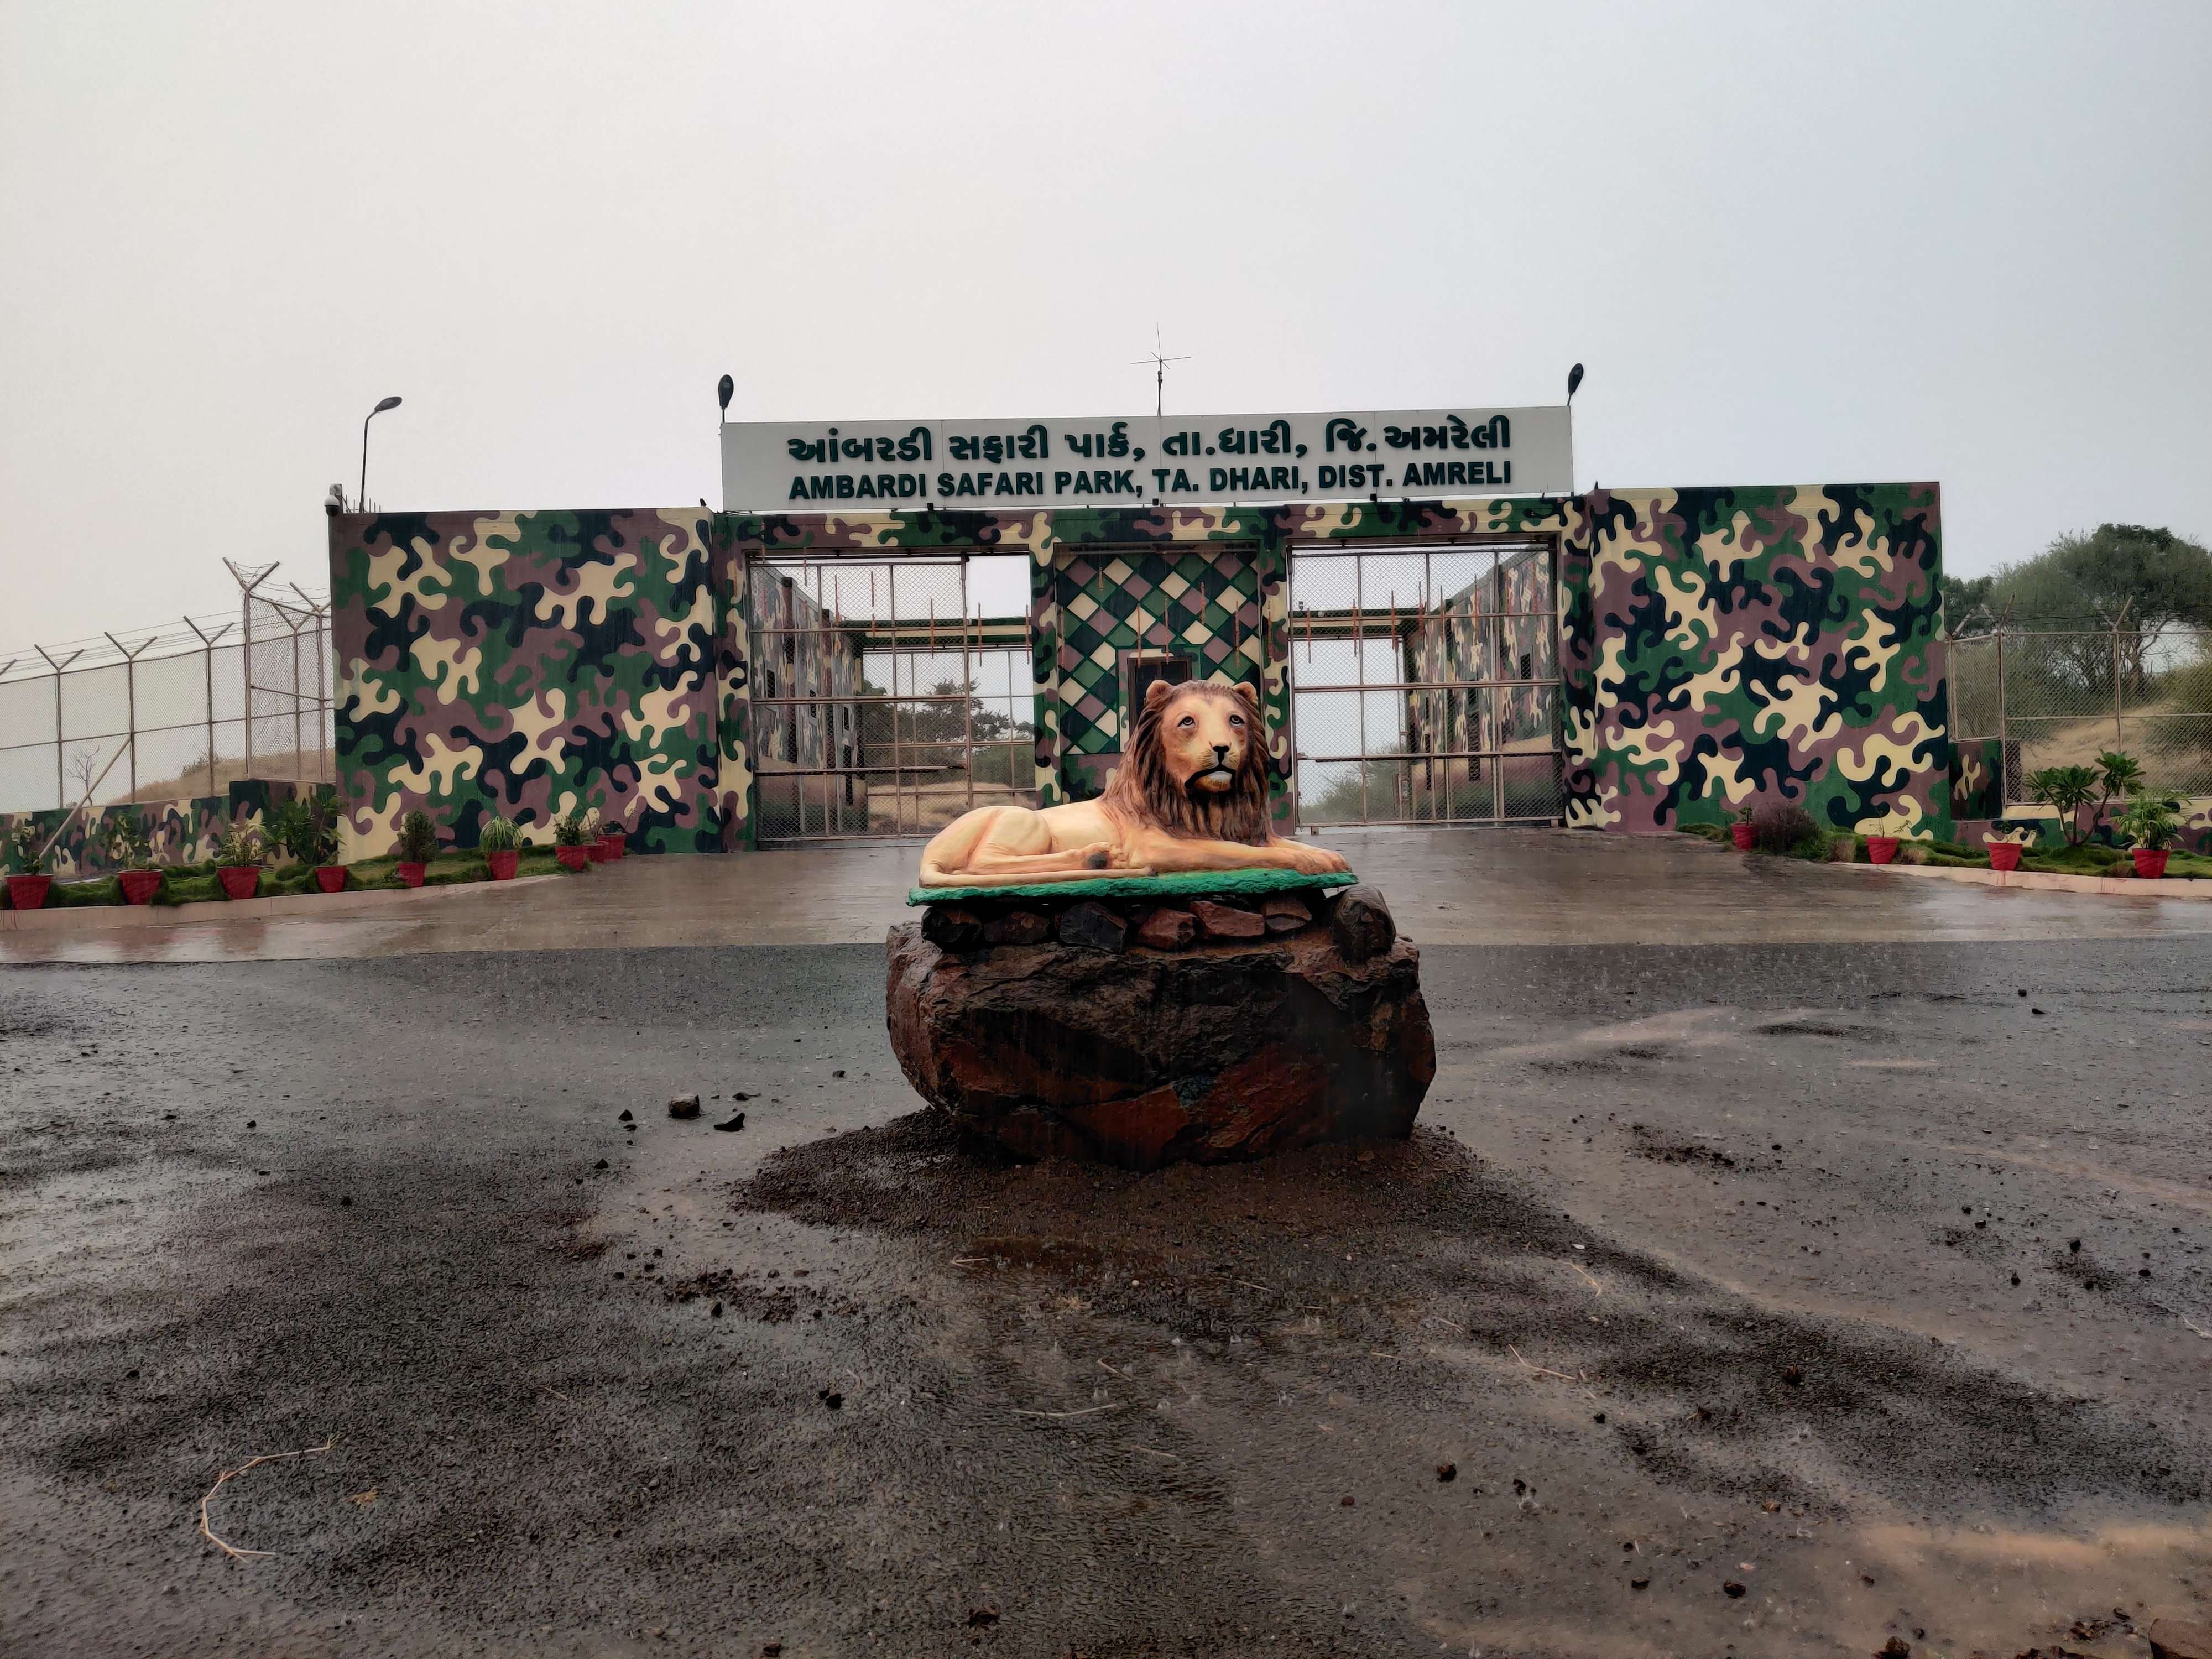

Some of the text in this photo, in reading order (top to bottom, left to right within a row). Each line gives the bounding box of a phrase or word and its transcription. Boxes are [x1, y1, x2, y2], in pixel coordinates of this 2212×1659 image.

[787, 427, 932, 463] આંબરડી
[948, 424, 1049, 465] સફારી
[1064, 421, 1146, 463] પાર્ક,
[789, 460, 1511, 500] AMBARDI SAFARI PARK, TA. DHARI, DIST. AMRELI
